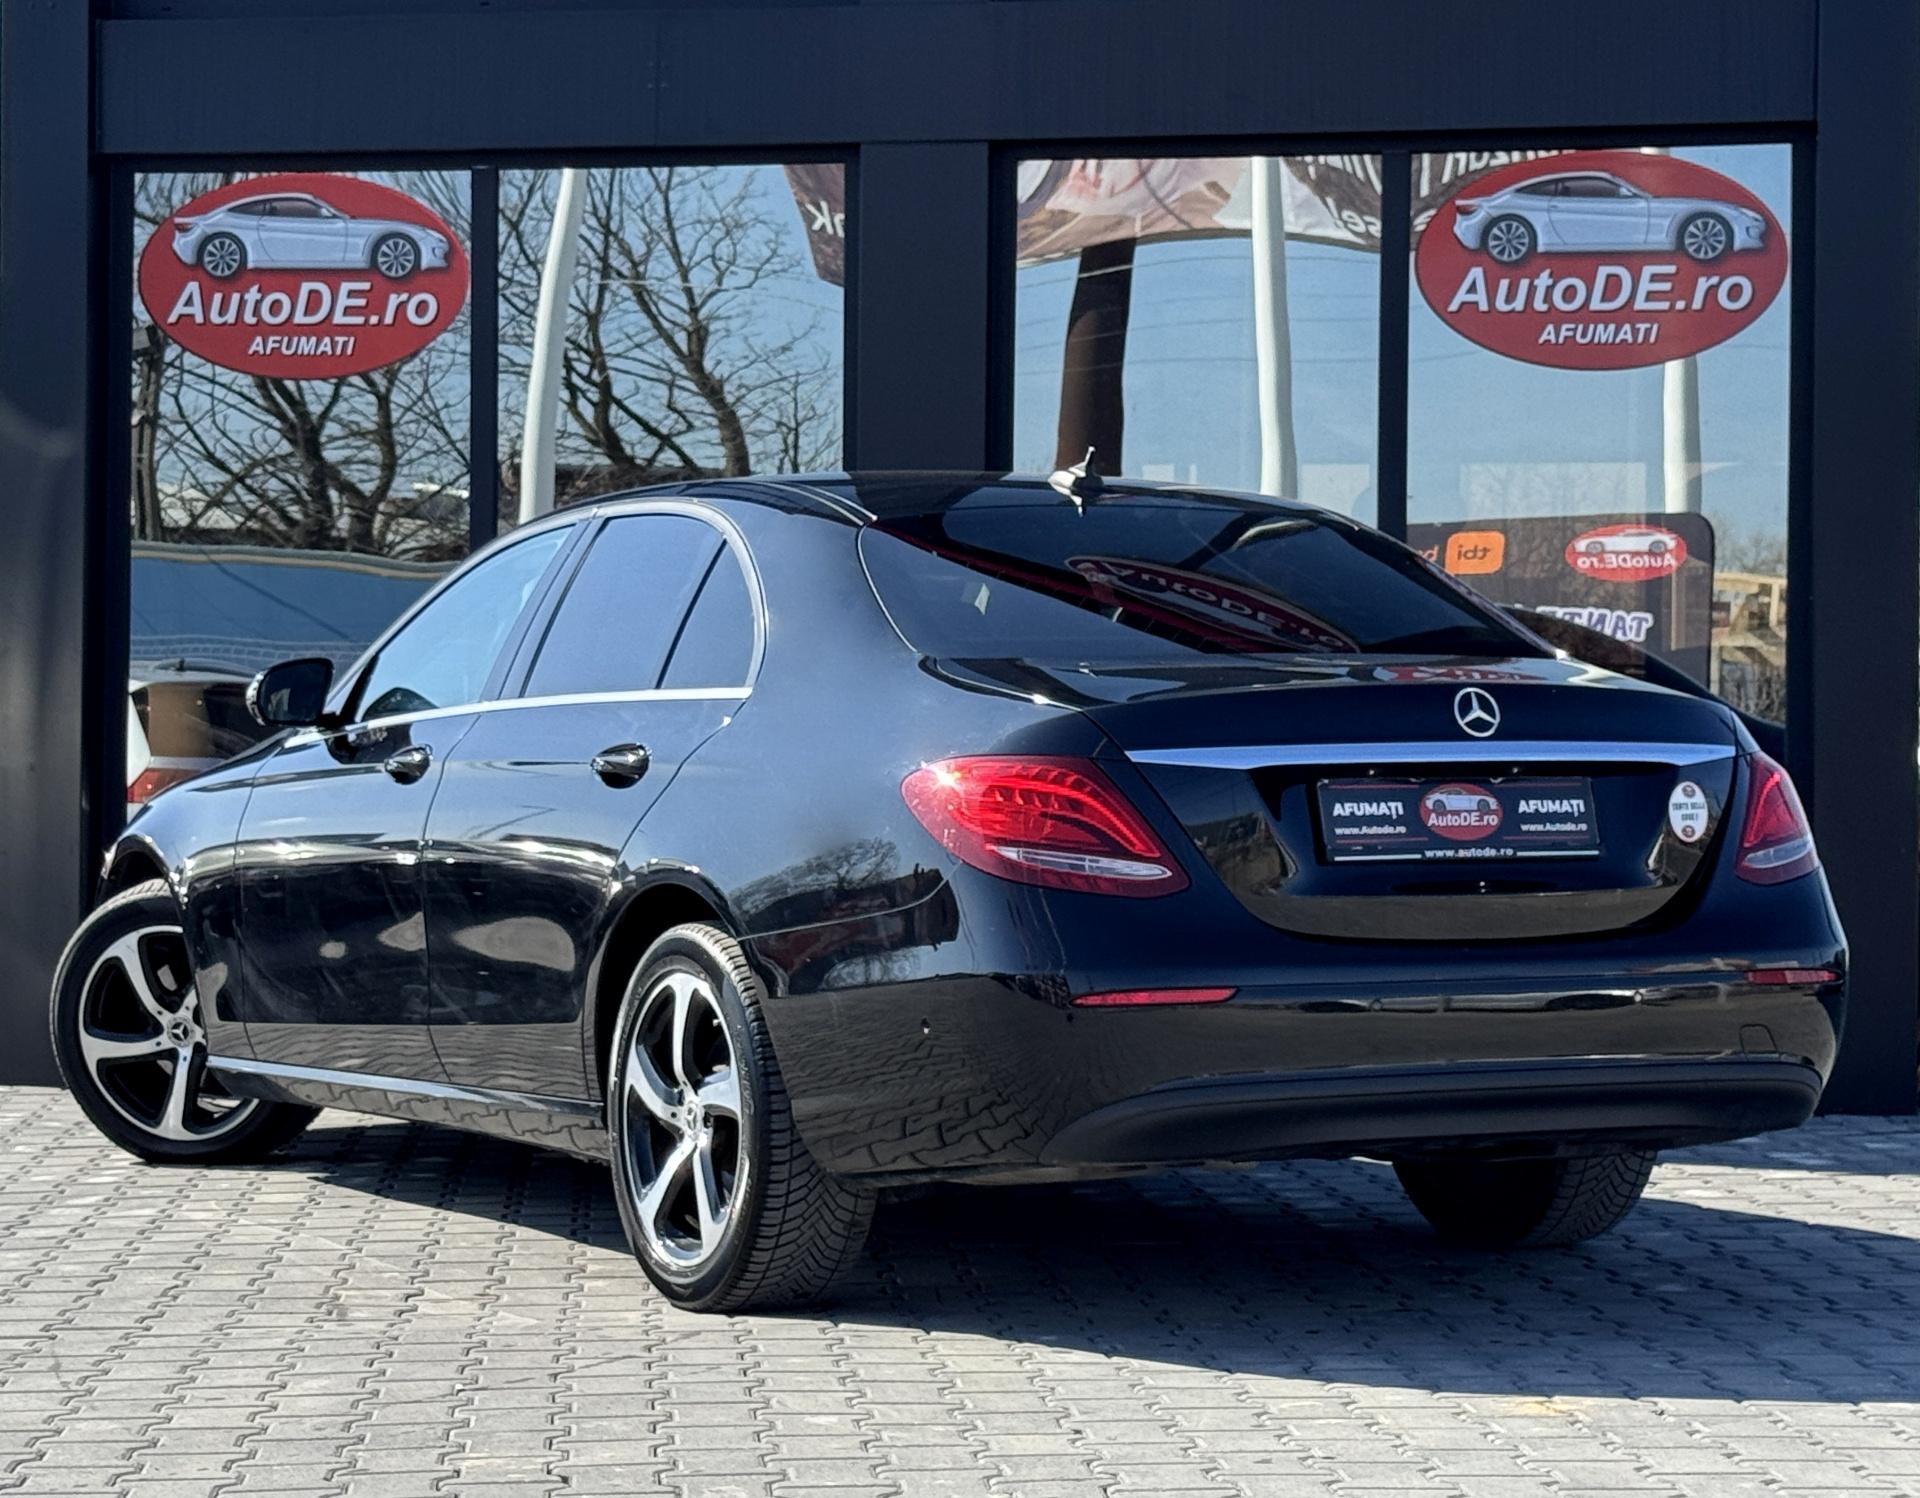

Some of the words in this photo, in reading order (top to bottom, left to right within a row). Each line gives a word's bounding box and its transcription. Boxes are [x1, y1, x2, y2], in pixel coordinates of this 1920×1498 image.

[1447, 265, 1753, 313] AutoDE.ro
[168, 281, 438, 327] AutoDE.ro
[1538, 323, 1659, 345] AFUMATI
[248, 336, 355, 356] AFUMATI
[1427, 812, 1499, 827] AutoDE.ro
